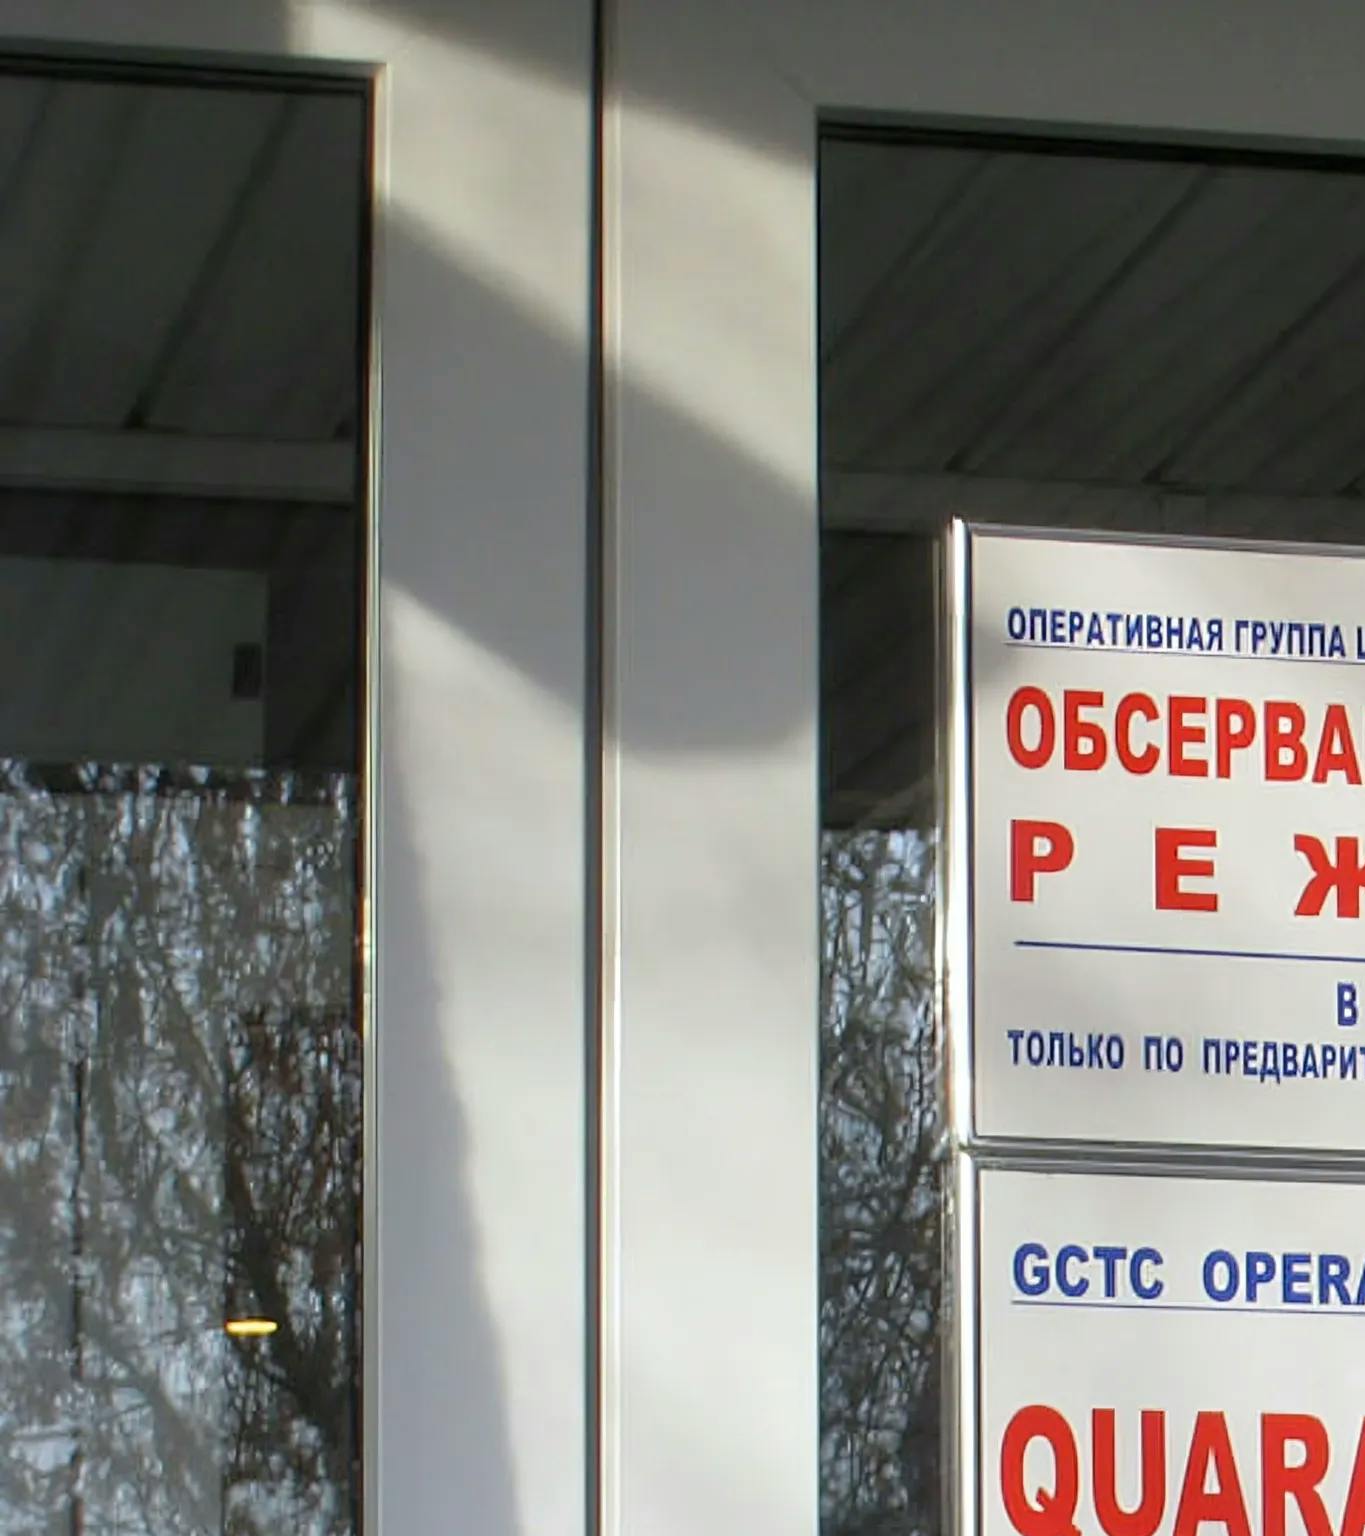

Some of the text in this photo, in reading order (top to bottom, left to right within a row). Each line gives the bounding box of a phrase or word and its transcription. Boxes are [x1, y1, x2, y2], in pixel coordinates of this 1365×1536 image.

[1007, 607, 1223, 651] ОПЕРАТИВНАЯ
[1235, 620, 1346, 658] ГРУППА
[1007, 1030, 1124, 1070] ТОЛЬКО
[1143, 1036, 1184, 1072] ПО
[1012, 1243, 1164, 1300] GCTC
